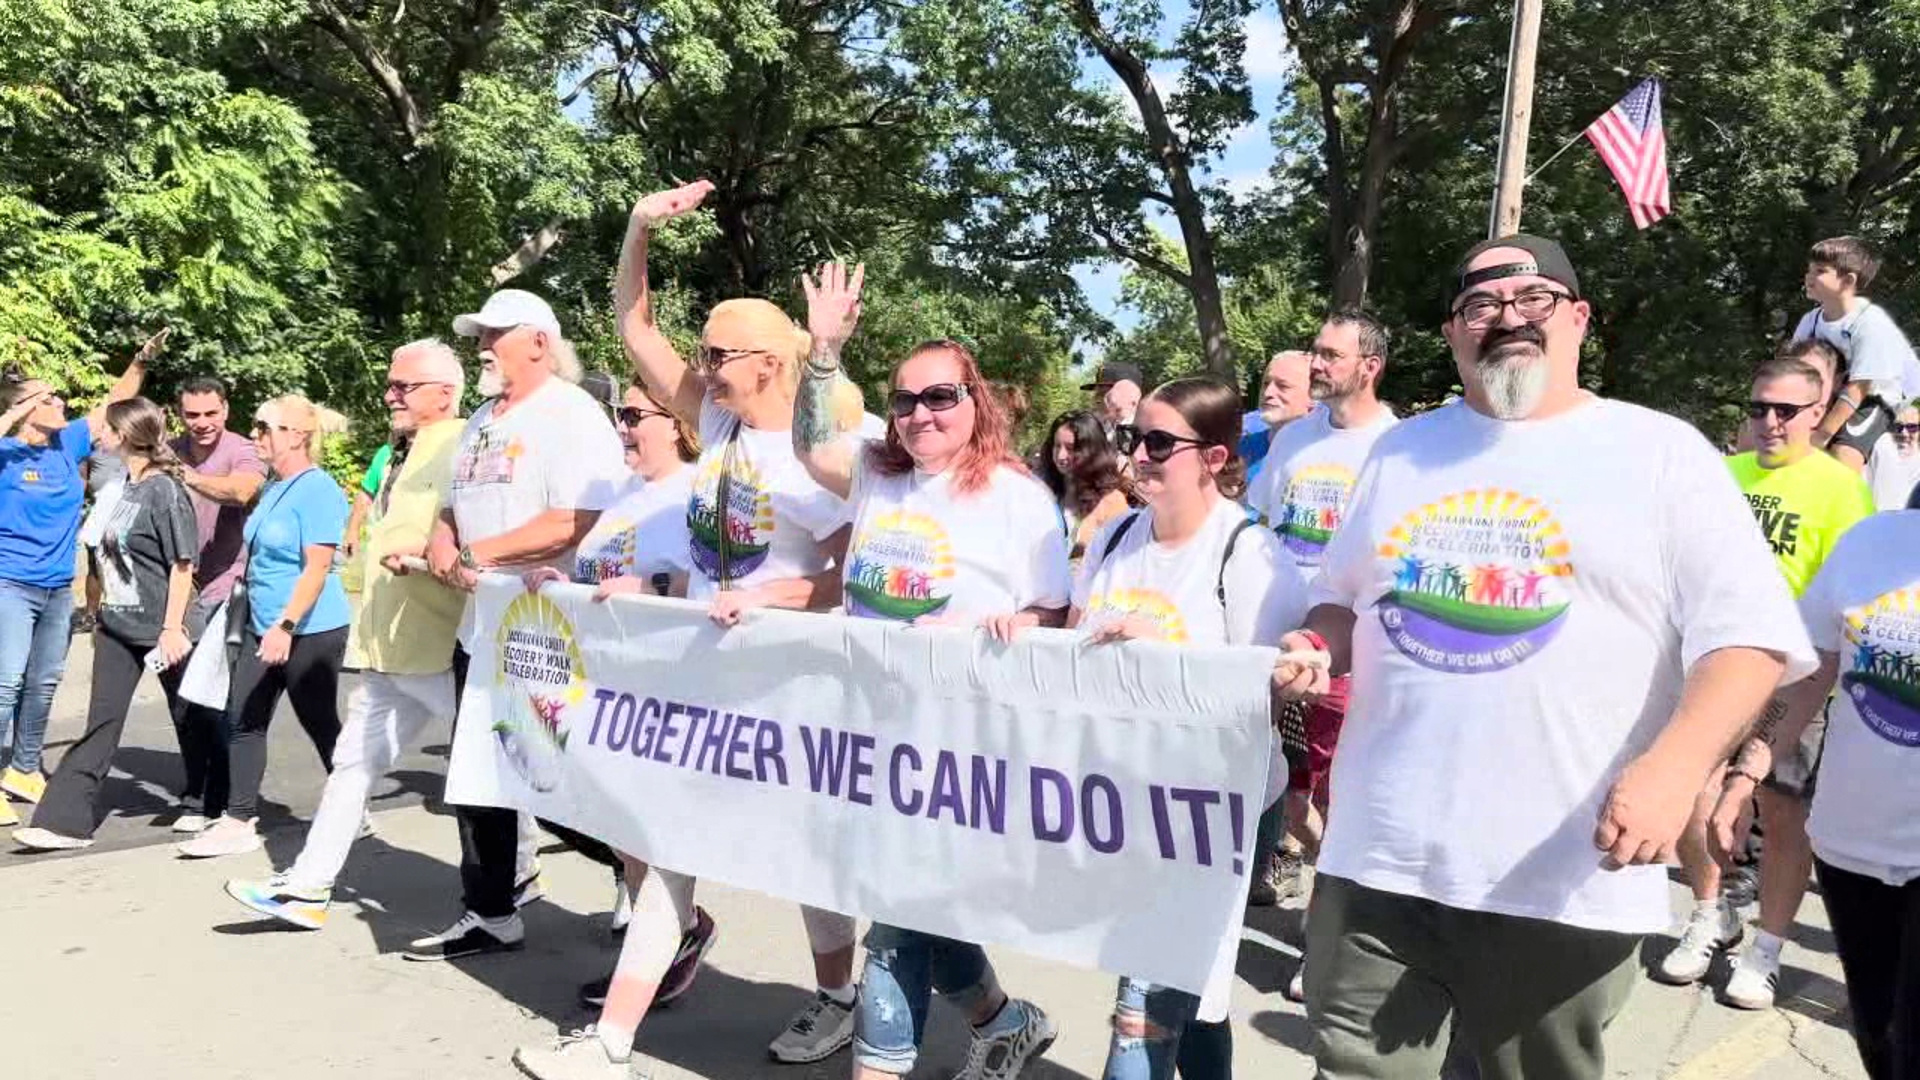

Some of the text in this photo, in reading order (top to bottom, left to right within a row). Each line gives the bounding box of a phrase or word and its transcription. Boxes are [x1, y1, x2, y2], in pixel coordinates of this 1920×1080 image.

[1411, 523, 1545, 546] RECOVERY WALK
[1425, 537, 1546, 560] CELEBRATION
[1876, 626, 1920, 645] CELE
[1396, 631, 1446, 666] TOGETHER
[1446, 652, 1465, 666] WE
[1467, 652, 1493, 666] CAN
[1493, 648, 1513, 663] DO
[546, 653, 571, 671] WALK
[588, 688, 789, 787] TOGETHER
[799, 725, 876, 807] WE
[889, 743, 1007, 836] CAN
[1029, 765, 1126, 855] DO
[1147, 784, 1246, 877] IT!
